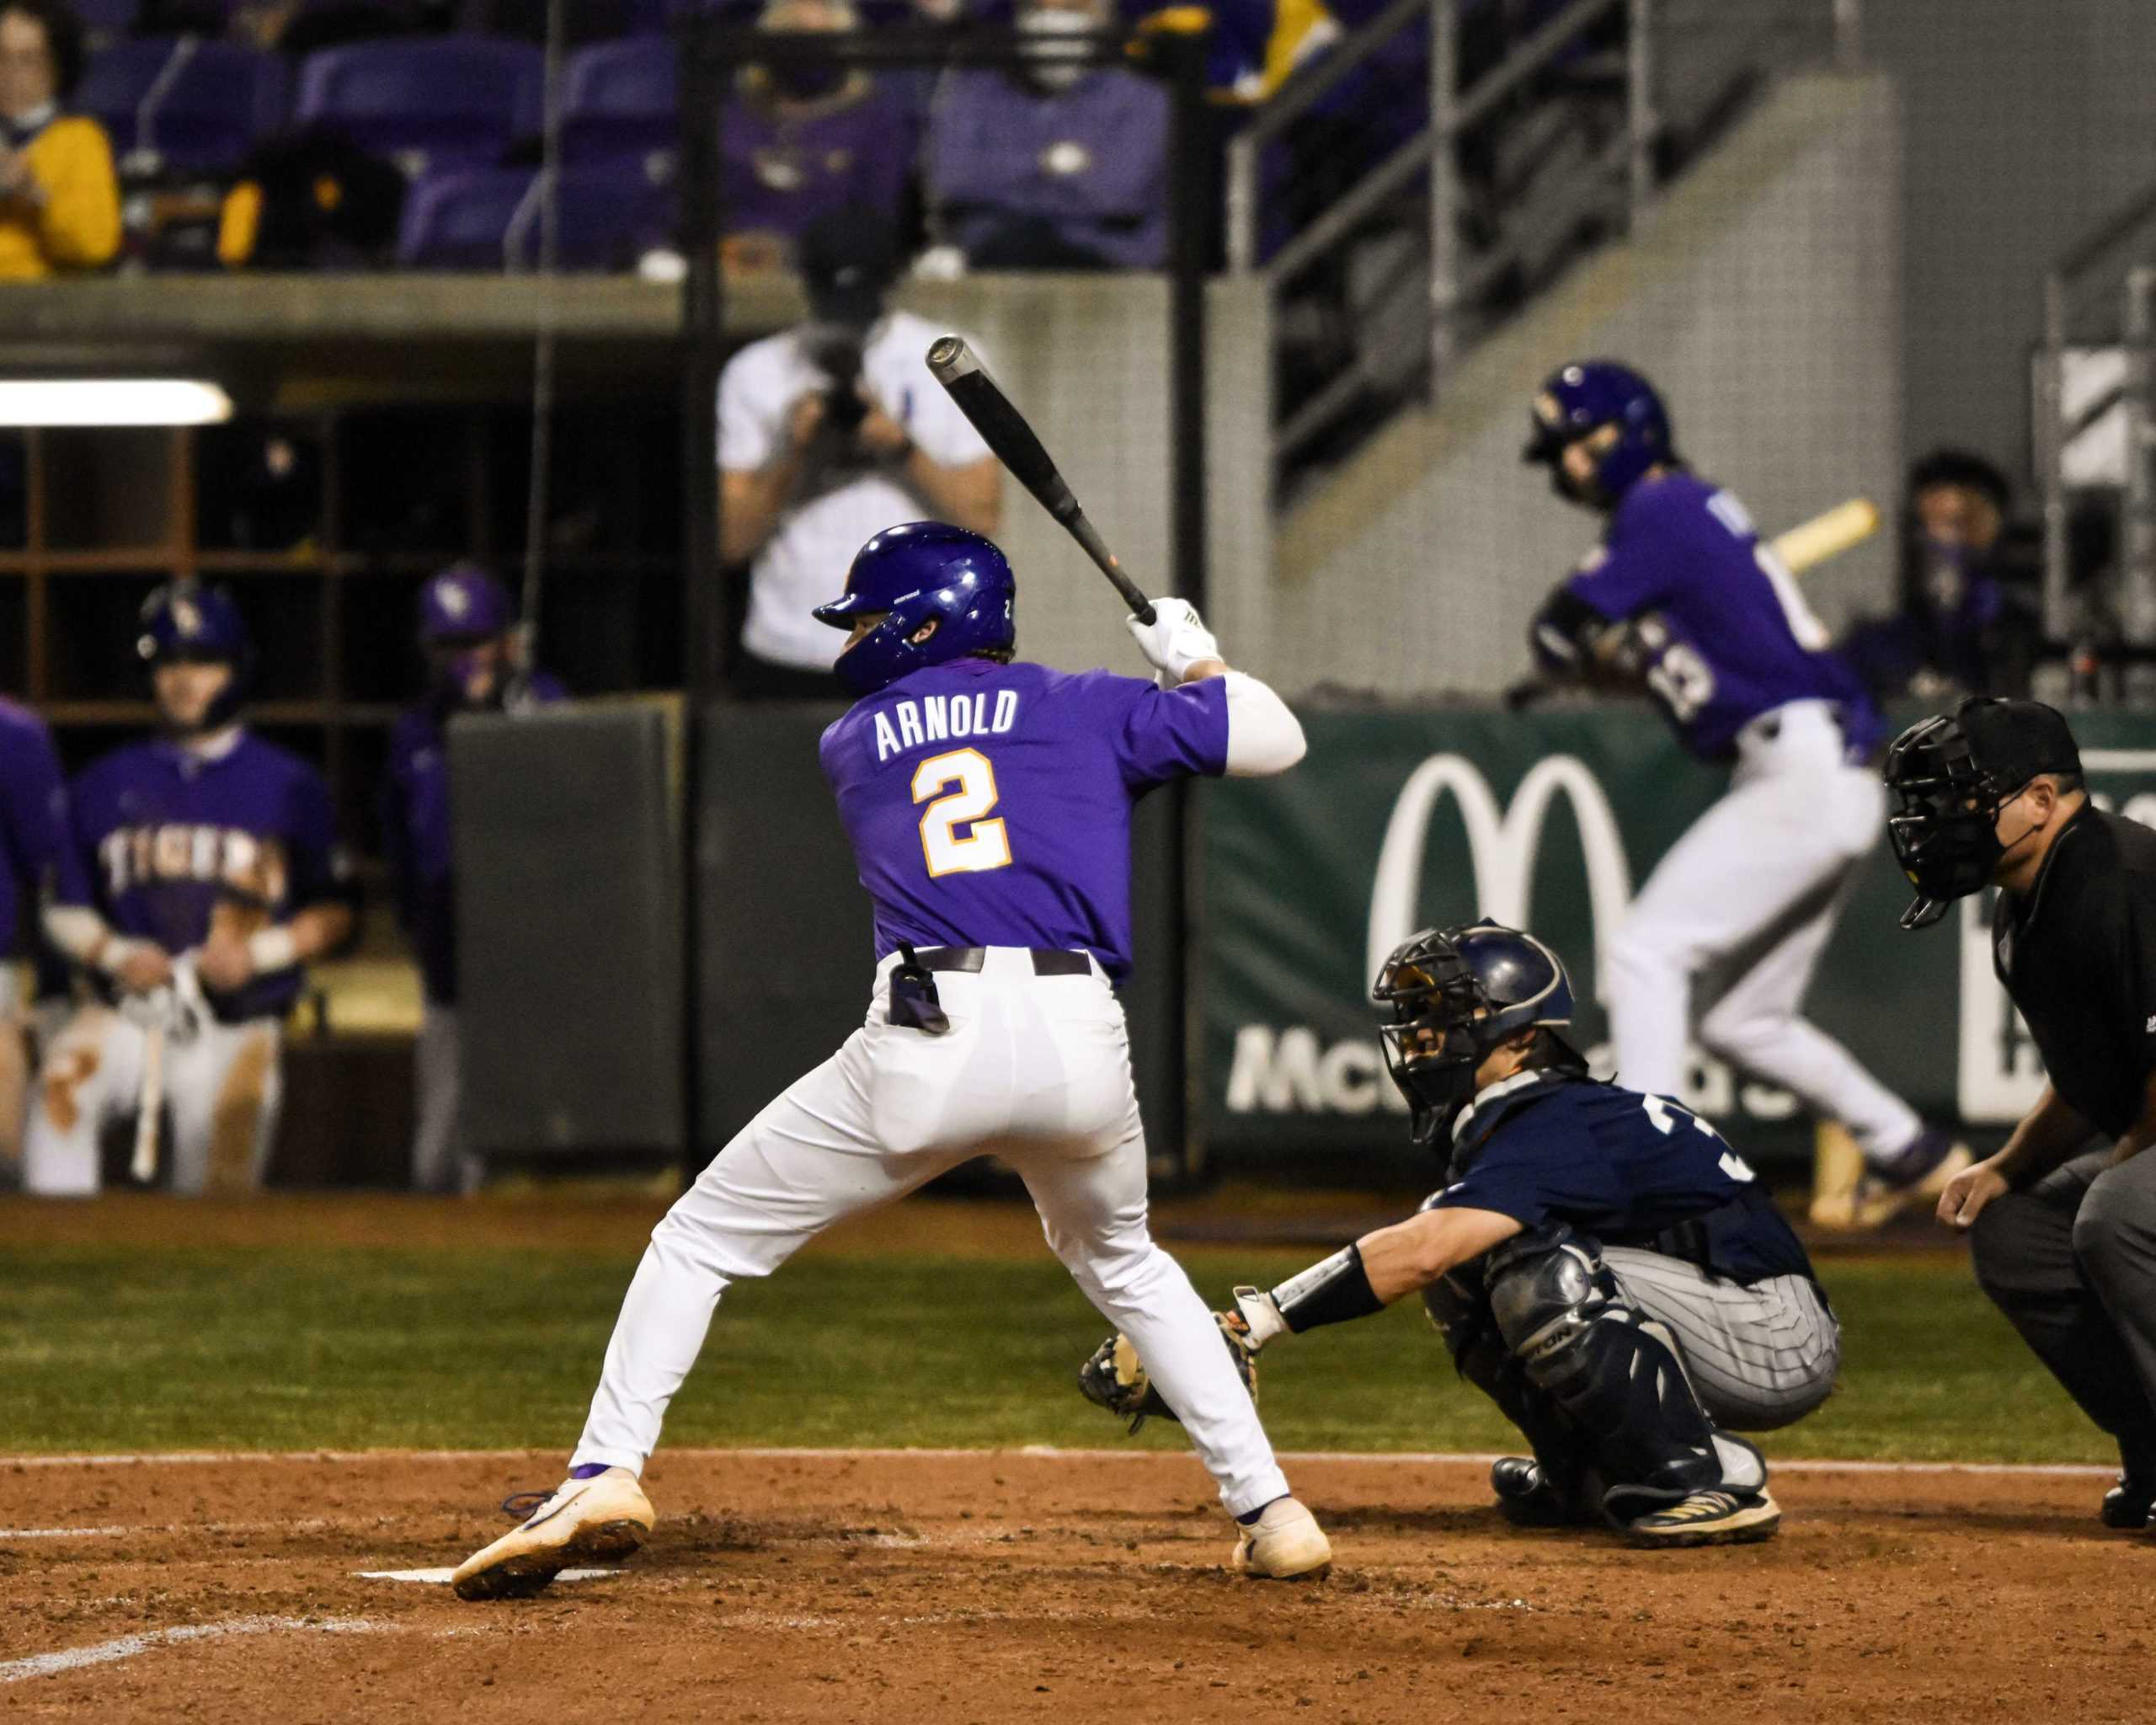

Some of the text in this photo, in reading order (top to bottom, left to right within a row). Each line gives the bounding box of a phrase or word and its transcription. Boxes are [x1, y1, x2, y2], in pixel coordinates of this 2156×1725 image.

[1004, 598, 1011, 620] 2
[874, 689, 1017, 761] ARNOLD
[910, 747, 1012, 879] 2
